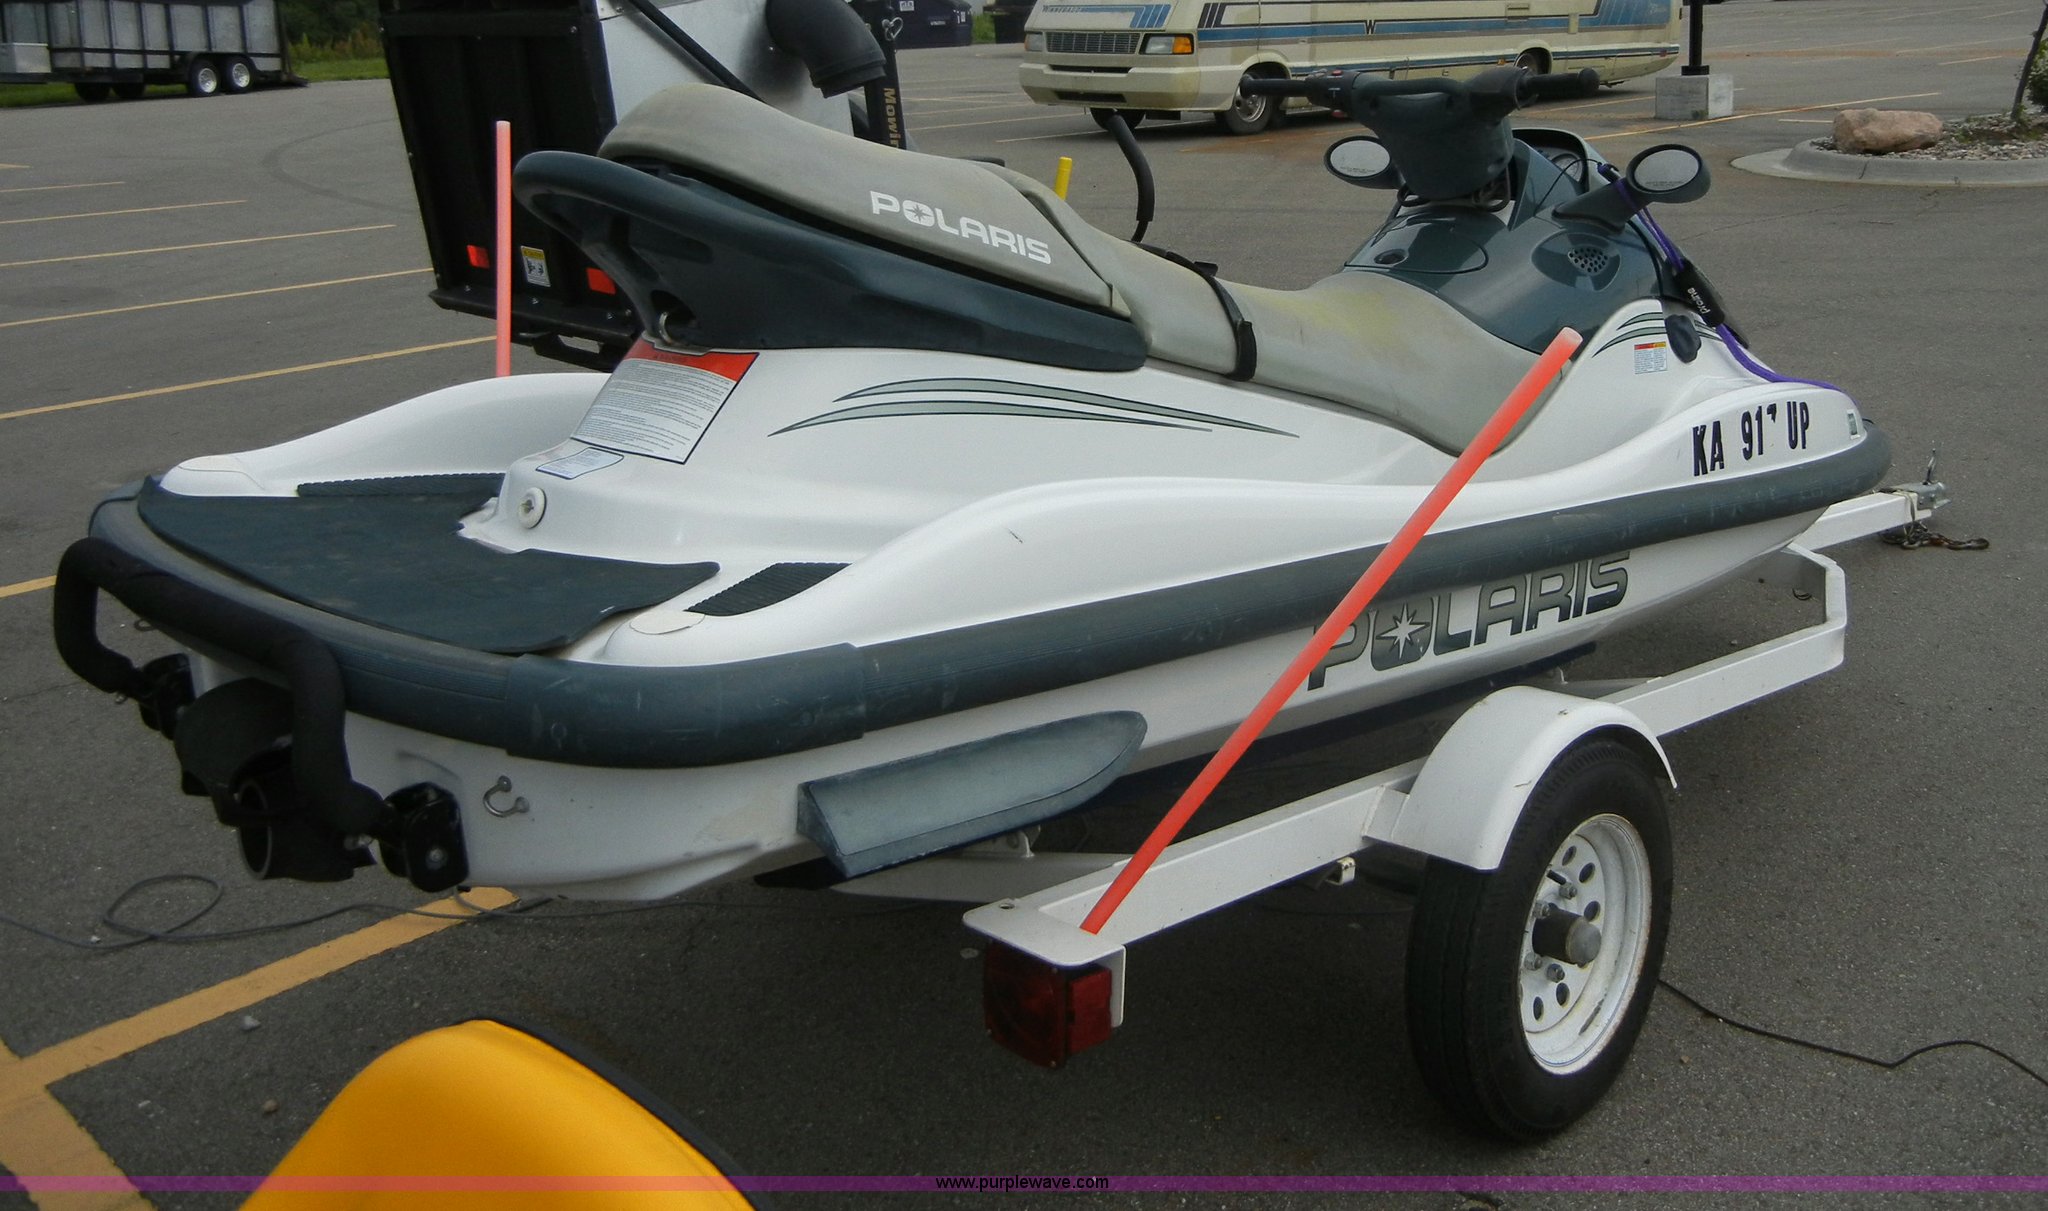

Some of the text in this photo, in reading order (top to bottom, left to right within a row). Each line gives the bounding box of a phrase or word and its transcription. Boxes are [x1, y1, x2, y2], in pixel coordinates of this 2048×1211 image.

[869, 190, 1051, 265] POLARIS
[1692, 420, 1724, 476] KA
[1787, 401, 1810, 449] UP
[1307, 551, 1630, 691] POLARIS
